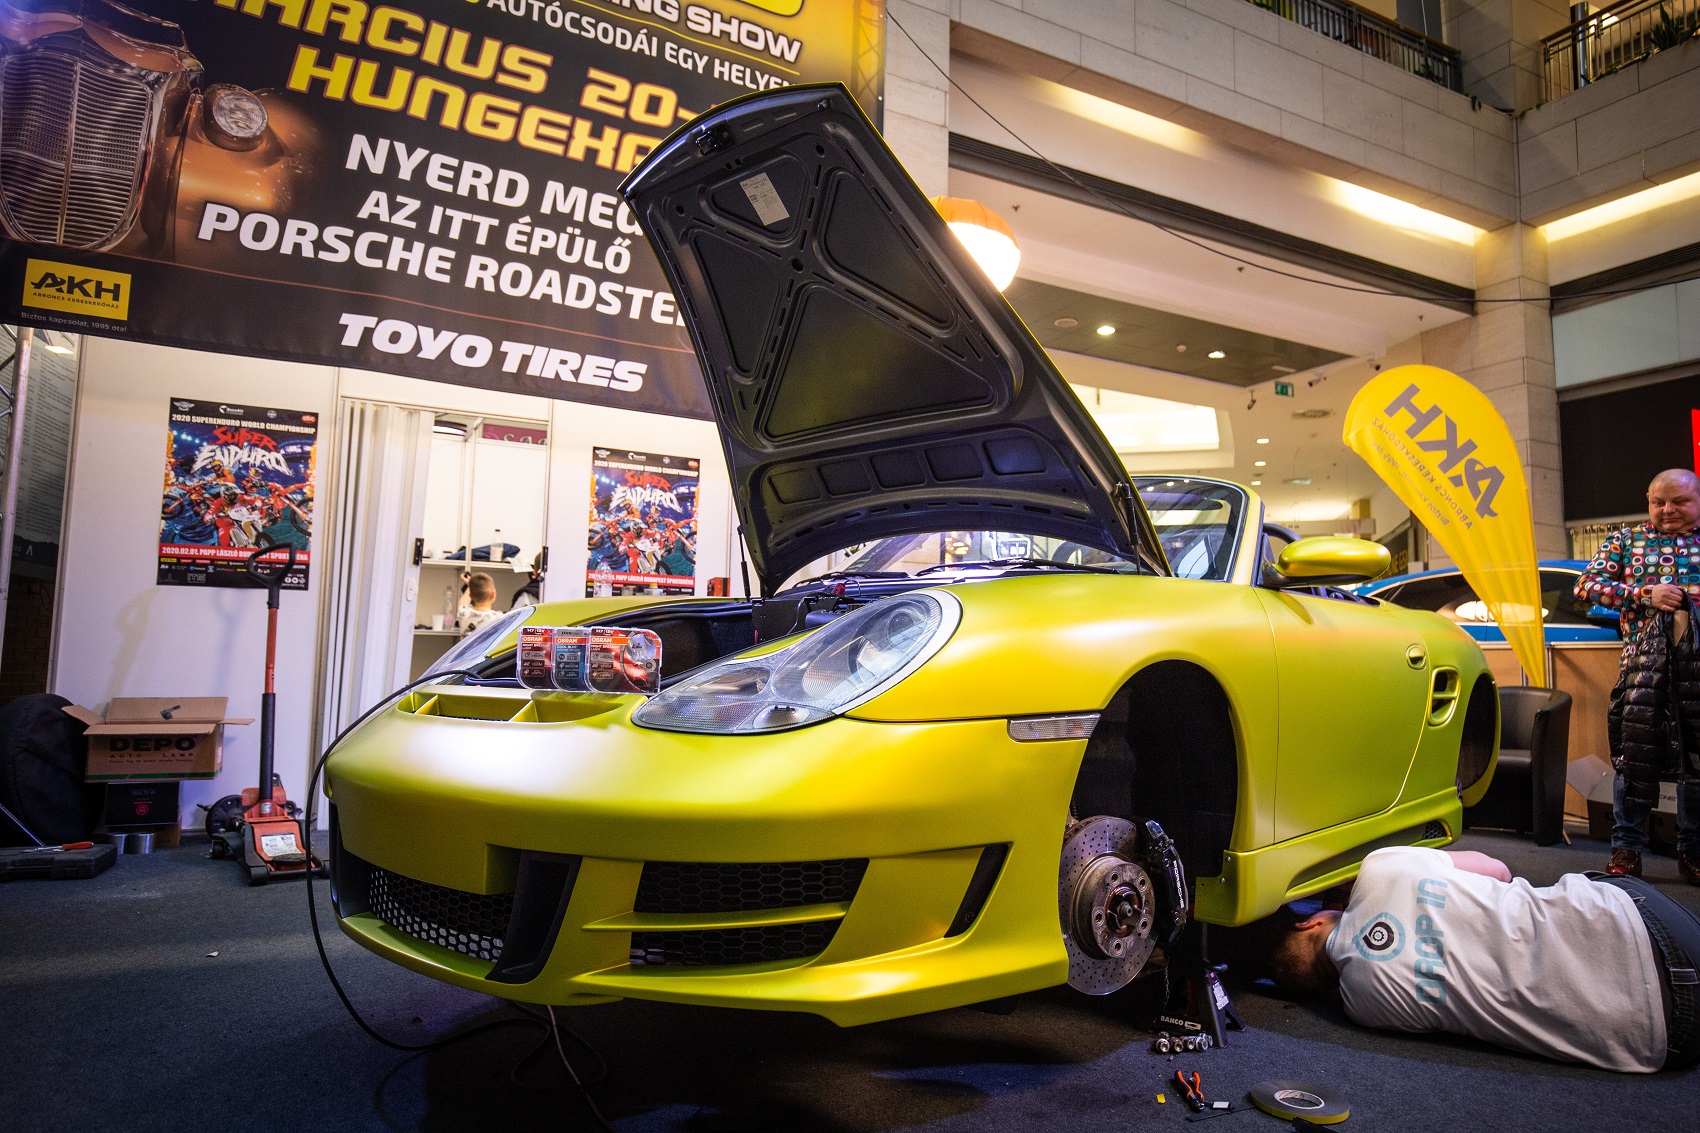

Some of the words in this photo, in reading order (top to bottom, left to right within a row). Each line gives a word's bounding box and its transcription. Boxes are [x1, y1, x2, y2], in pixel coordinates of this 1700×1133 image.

[487, 0, 658, 57] AUTÓCSODÁI
[664, 41, 709, 74] EGY
[686, 5, 802, 63] SHOW
[345, 133, 530, 208] NYERD
[540, 180, 644, 236] MEG
[197, 202, 456, 285] PORSCHE
[356, 190, 421, 229] AZ
[428, 205, 499, 245] ITT
[505, 215, 632, 274] ÉPÜLŐ
[30, 272, 121, 302] AKH
[32, 292, 65, 301] ABRONCS
[21, 311, 47, 321] Biztos
[48, 315, 89, 328] kapcsolat,
[91, 321, 110, 330] 1995
[339, 313, 493, 368] TOYO
[500, 340, 648, 392] TIRES
[171, 413, 191, 422] 2020
[192, 416, 240, 427] SUPERENDURO
[241, 420, 266, 430] WORLD
[265, 422, 316, 434] CHAMPIONSHIP
[190, 445, 295, 477] ENDURO
[199, 548, 216, 557] PAPP
[109, 737, 195, 751] DEPO
[1416, 877, 1449, 910] IN
[1414, 913, 1448, 1005] DROP
[1160, 1015, 1184, 1027] BAHCO
